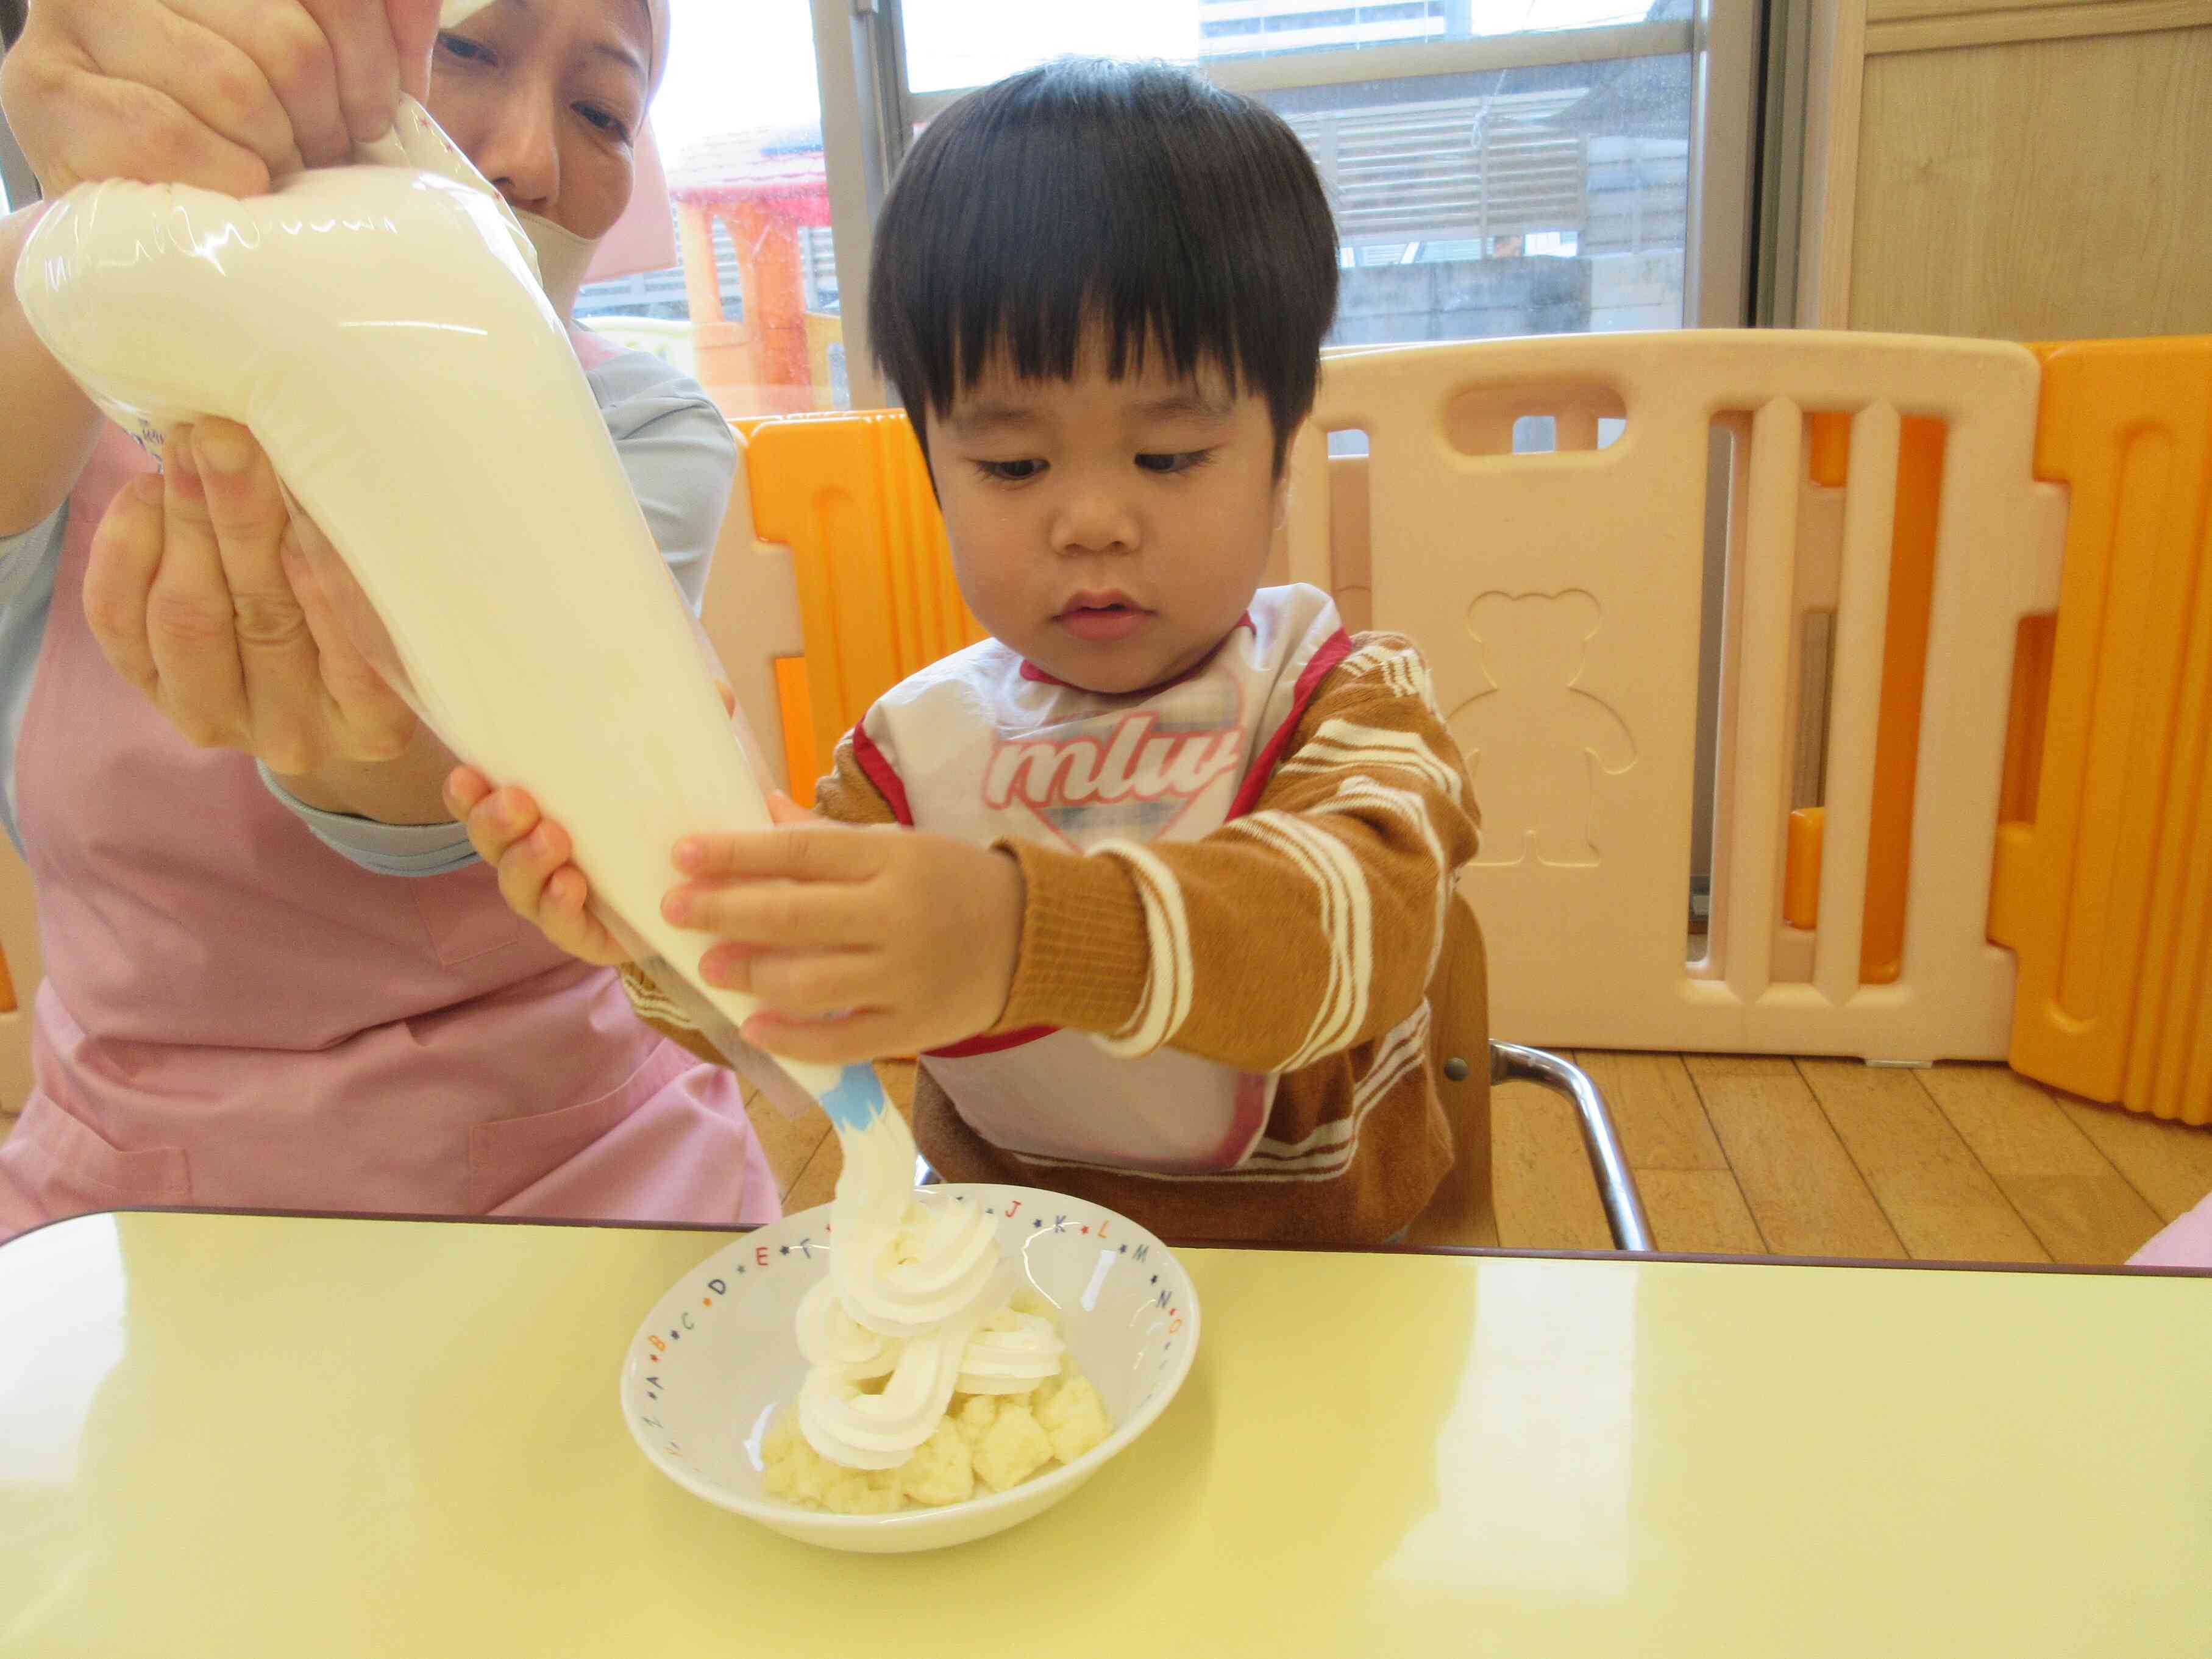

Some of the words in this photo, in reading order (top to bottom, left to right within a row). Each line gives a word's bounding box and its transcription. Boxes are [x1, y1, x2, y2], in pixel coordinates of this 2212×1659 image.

[648, 1335, 666, 1351] B
[681, 1312, 694, 1330] C
[708, 1279, 726, 1295] D
[755, 1247, 769, 1266] E
[1005, 1199, 1022, 1218] J
[1054, 1215, 1067, 1234] K
[1097, 1220, 1109, 1239] L
[1132, 1244, 1150, 1263] M
[1156, 1289, 1172, 1309] N
